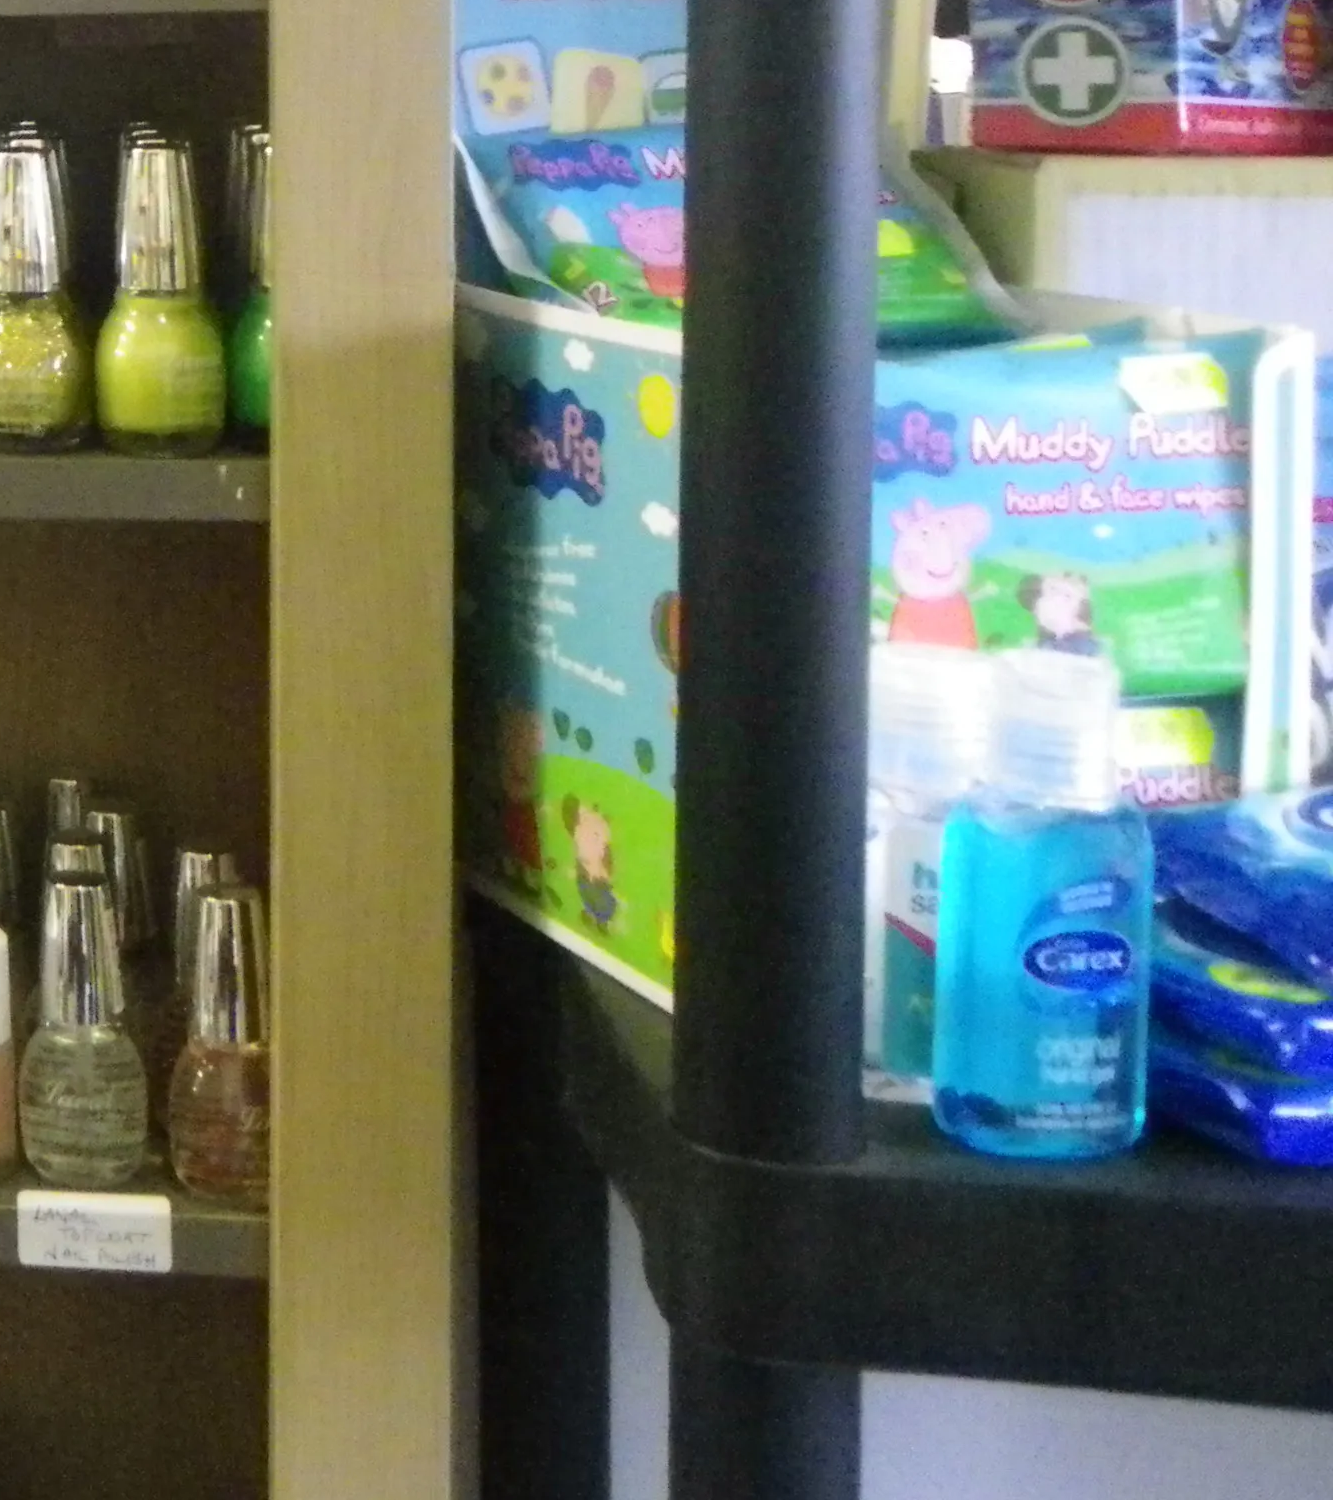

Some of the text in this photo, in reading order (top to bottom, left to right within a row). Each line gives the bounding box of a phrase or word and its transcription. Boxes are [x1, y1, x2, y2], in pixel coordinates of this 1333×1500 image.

[970, 415, 1112, 472] Muddy
[1003, 480, 1071, 515] hand
[1108, 474, 1164, 514] face
[1035, 948, 1124, 973] Carex
